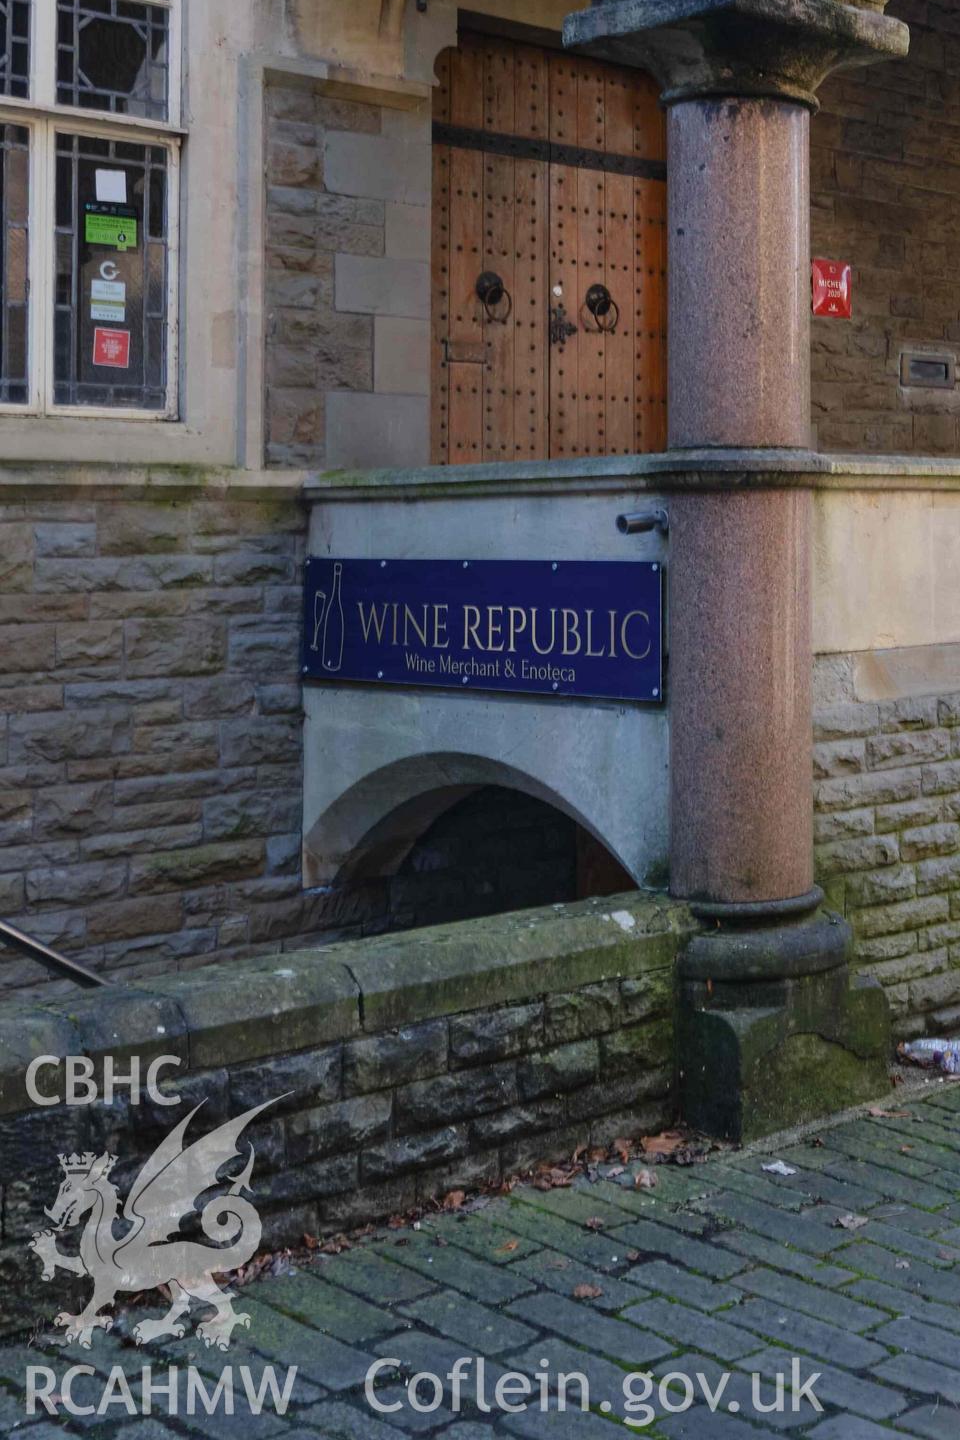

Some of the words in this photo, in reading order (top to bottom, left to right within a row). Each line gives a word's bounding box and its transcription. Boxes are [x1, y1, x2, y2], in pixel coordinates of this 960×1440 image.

[357, 602, 450, 649] WINE
[462, 605, 652, 660] REPUBLIC
[405, 652, 436, 672] Wine
[439, 656, 500, 677] Merchant
[504, 660, 517, 678] &
[521, 660, 576, 682] Enoteca
